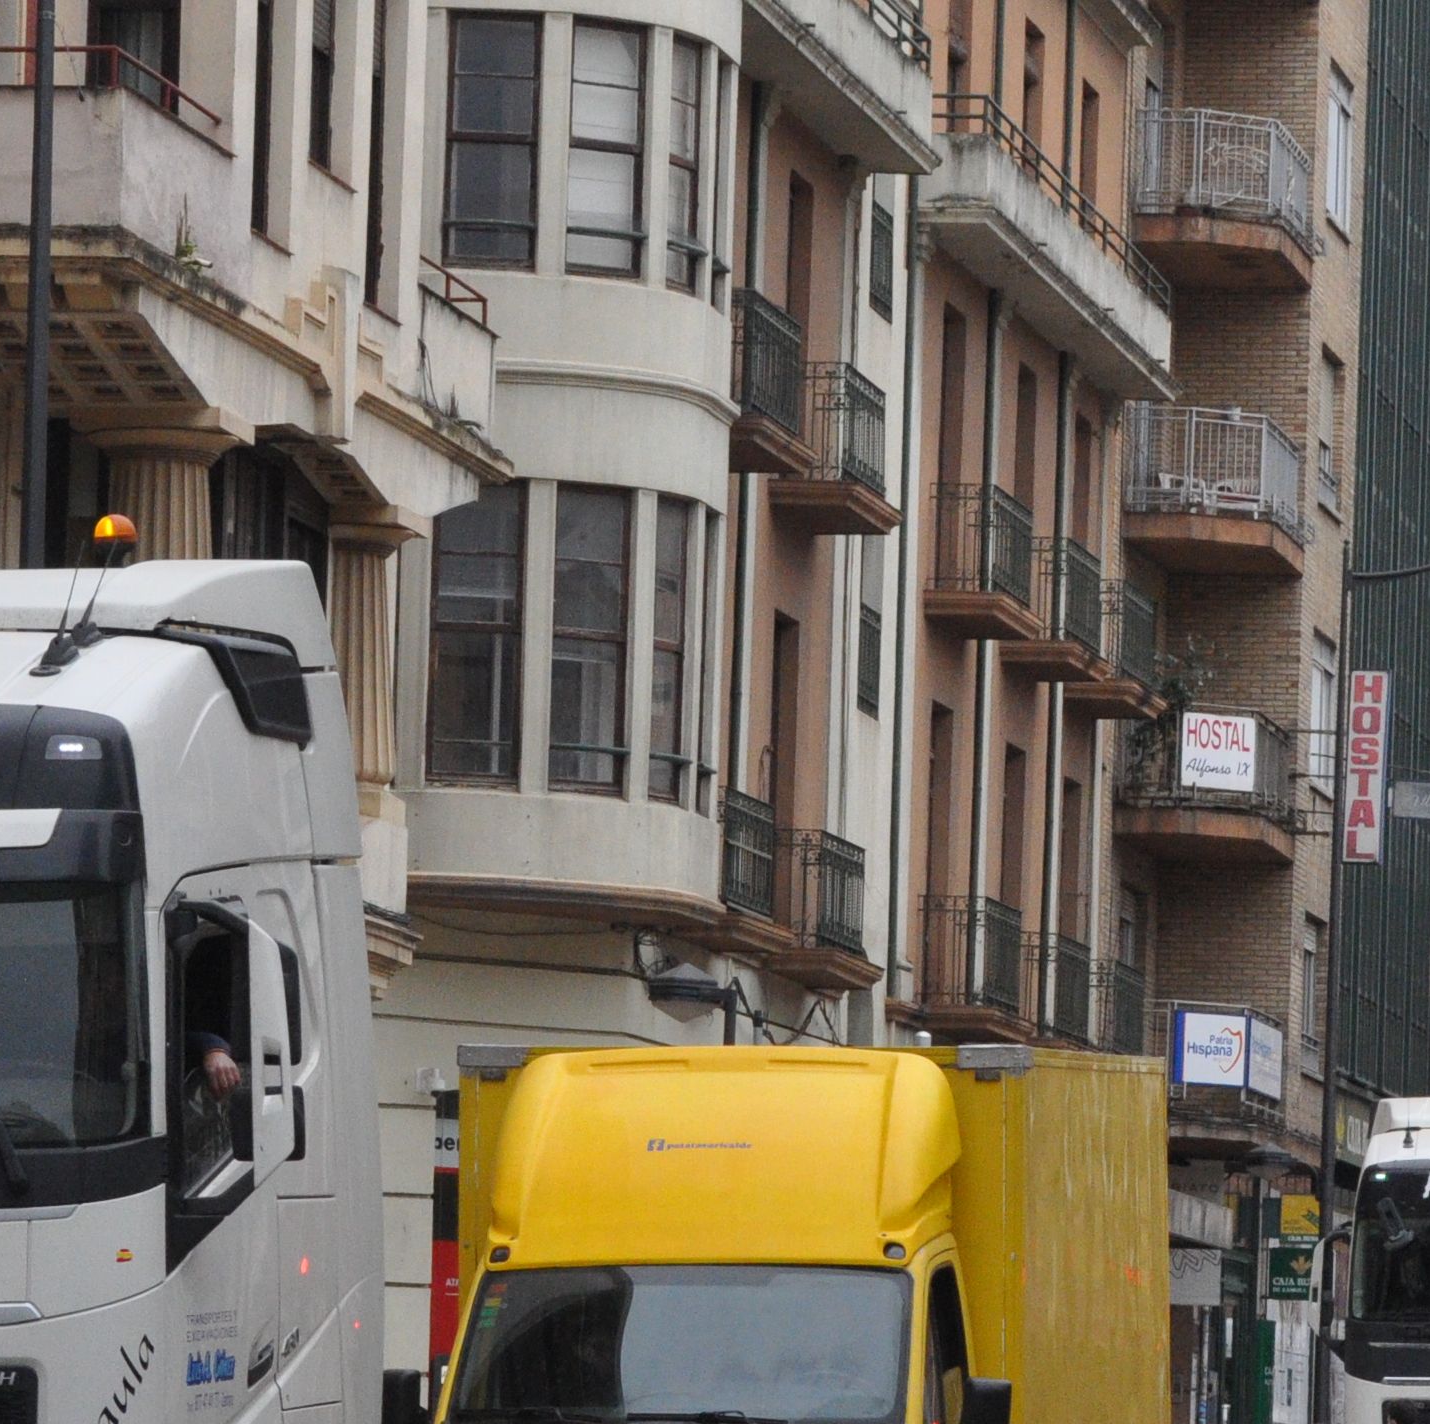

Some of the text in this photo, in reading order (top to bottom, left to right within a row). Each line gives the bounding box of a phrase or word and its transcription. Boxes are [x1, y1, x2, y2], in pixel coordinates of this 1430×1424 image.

[1187, 718, 1250, 752] HOSTAL
[1185, 758, 1250, 777] Alfonso IX
[1345, 674, 1383, 859] HOSTAL
[1209, 1034, 1233, 1045] Patria
[1187, 1042, 1233, 1057] Hispana
[1273, 1277, 1295, 1286] CAJA
